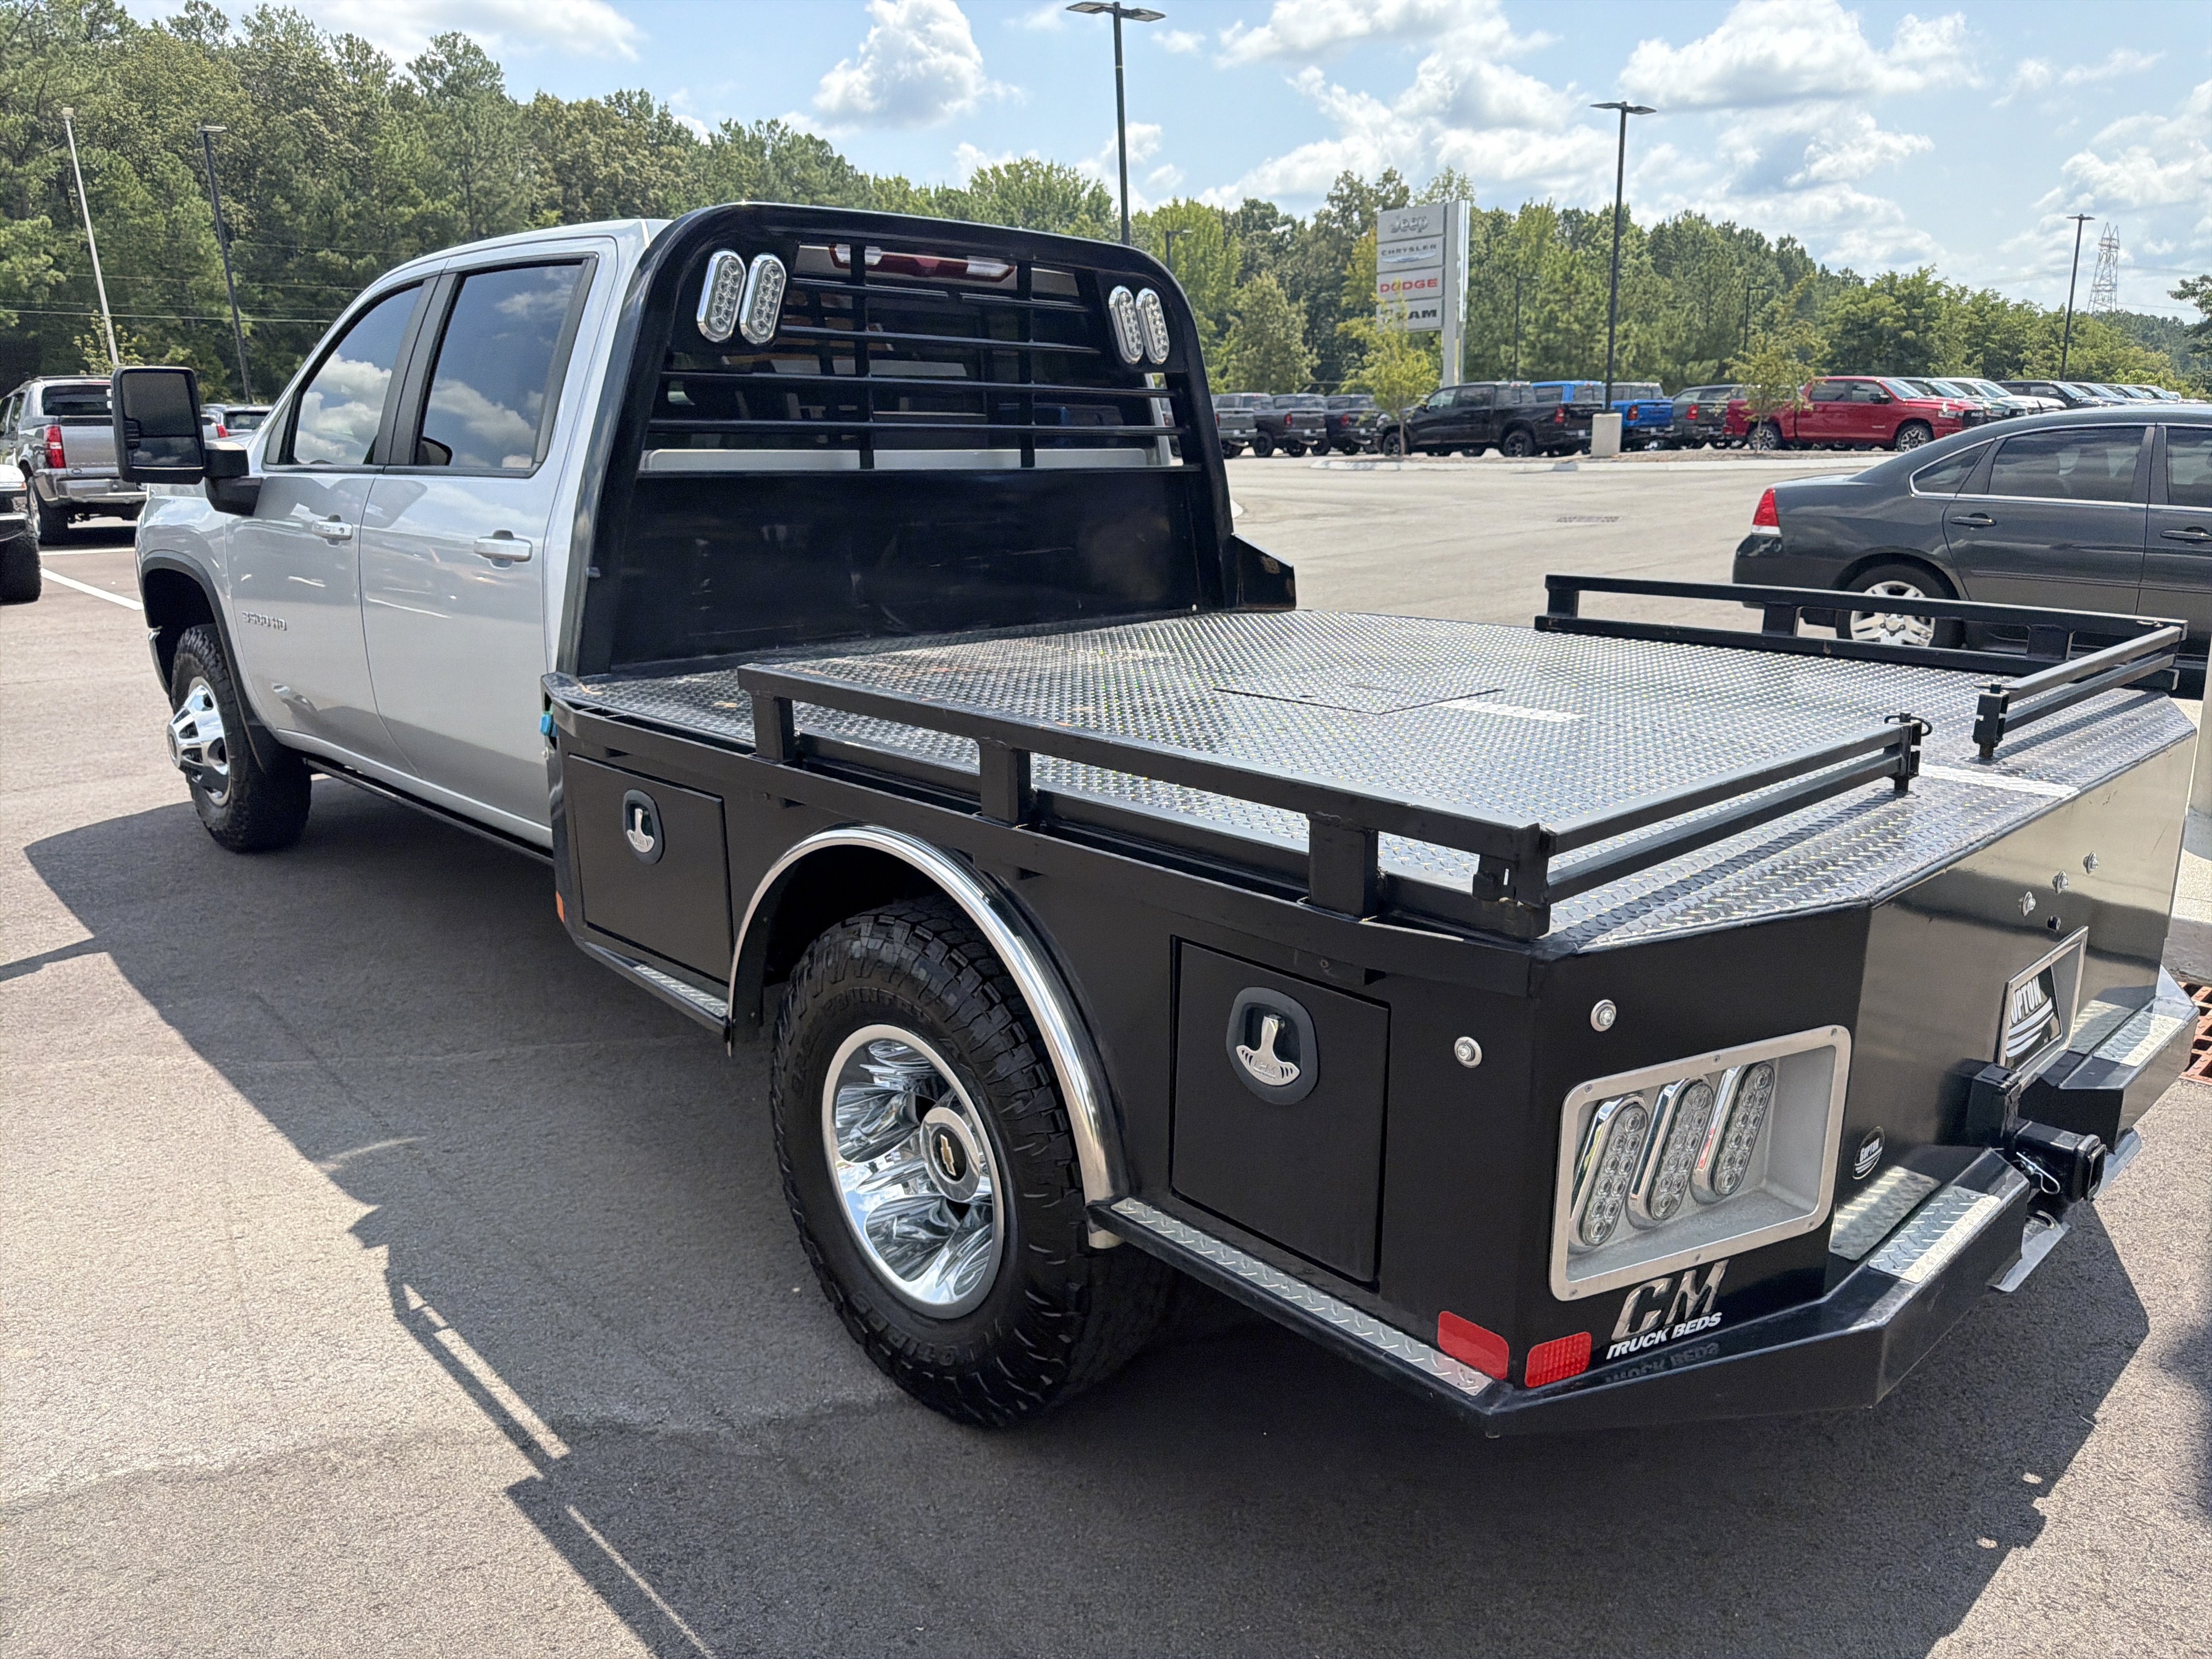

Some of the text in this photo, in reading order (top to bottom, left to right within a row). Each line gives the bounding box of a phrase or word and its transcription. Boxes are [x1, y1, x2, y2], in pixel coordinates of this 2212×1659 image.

[1390, 215, 1428, 233] Jeep
[1381, 244, 1437, 256] CHRYSLER
[2010, 975, 2042, 1025] UPTON
[1611, 1259, 1729, 1342] CM
[1606, 1312, 1723, 1359] TRUCK BEDS
